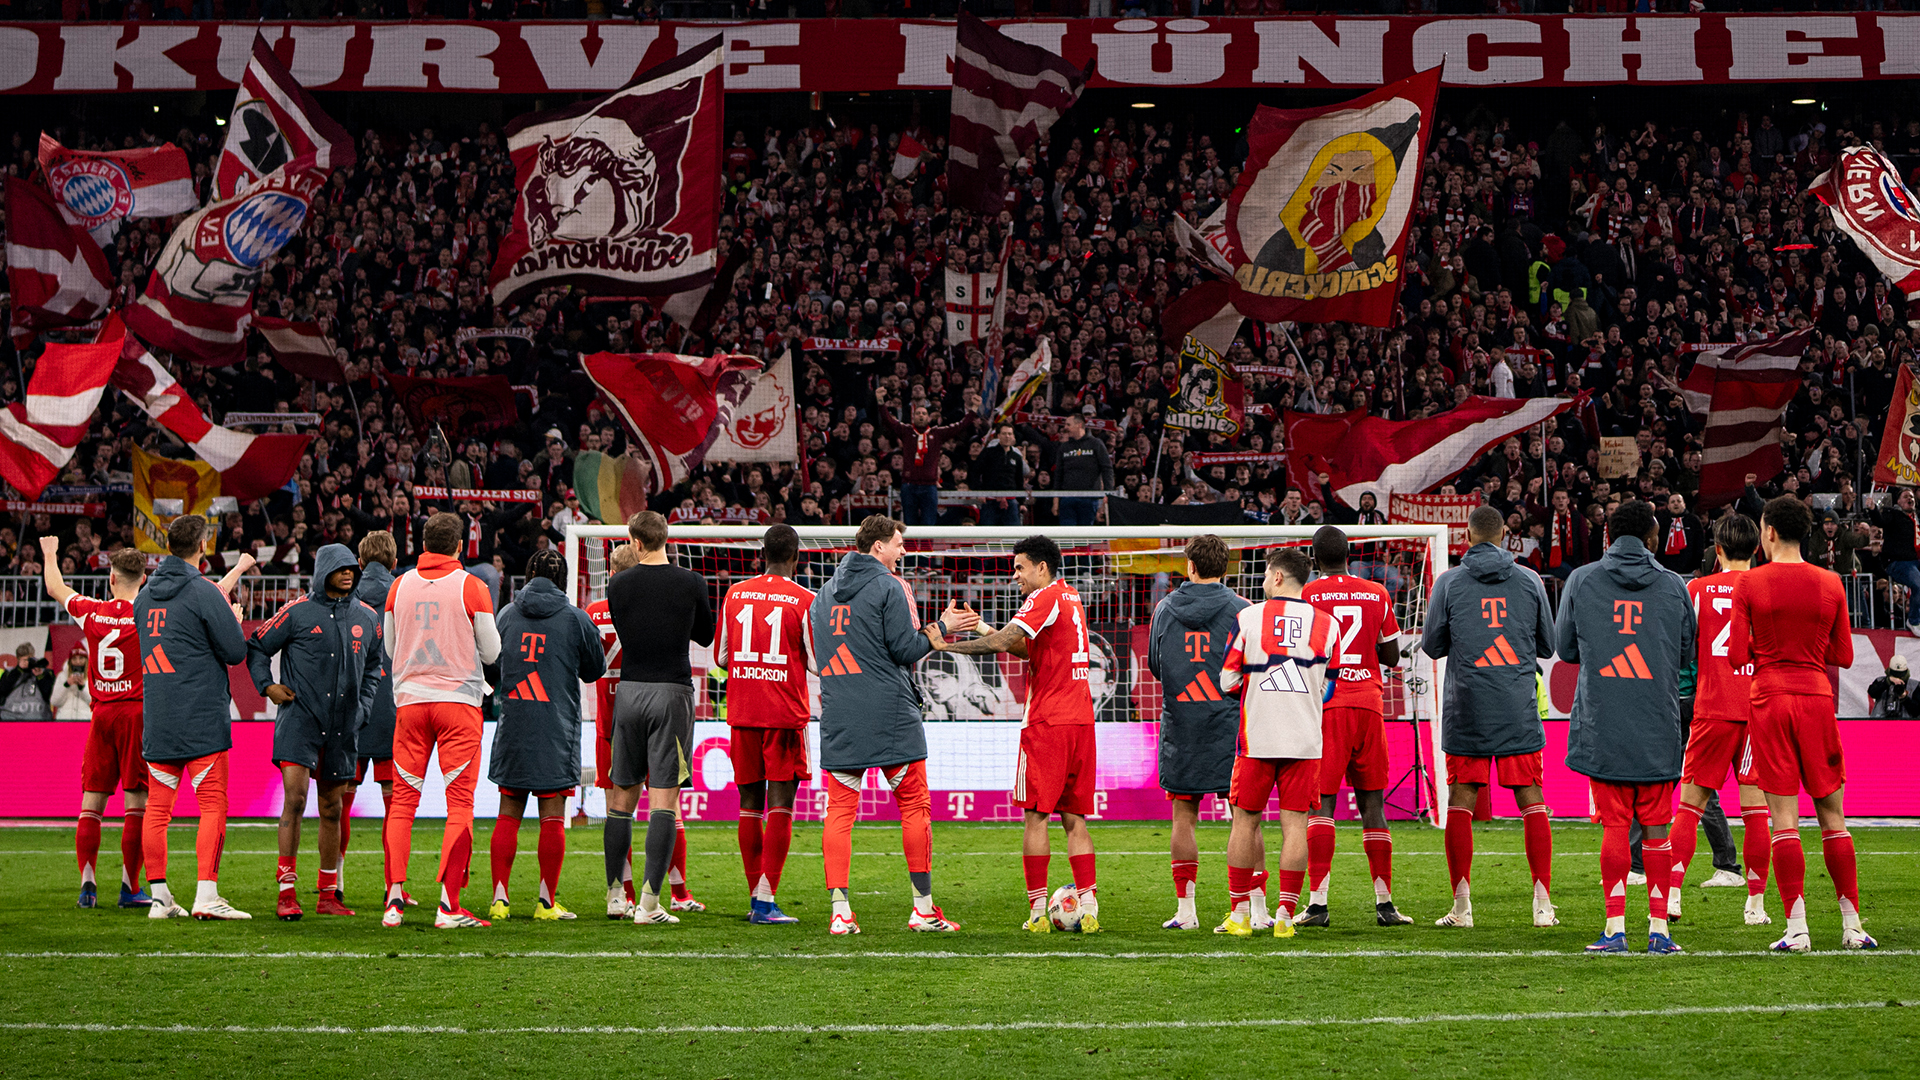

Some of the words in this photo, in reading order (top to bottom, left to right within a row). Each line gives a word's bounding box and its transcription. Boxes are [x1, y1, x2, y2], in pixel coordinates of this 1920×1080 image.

[1706, 585, 1716, 593] FC
[732, 591, 740, 599] FC
[741, 591, 766, 601] BAYERN
[1310, 594, 1320, 602] FC
[1322, 592, 1349, 601] BAYERN
[735, 604, 788, 664] 11
[98, 628, 124, 679] 6
[733, 667, 788, 682] N.JACKSON
